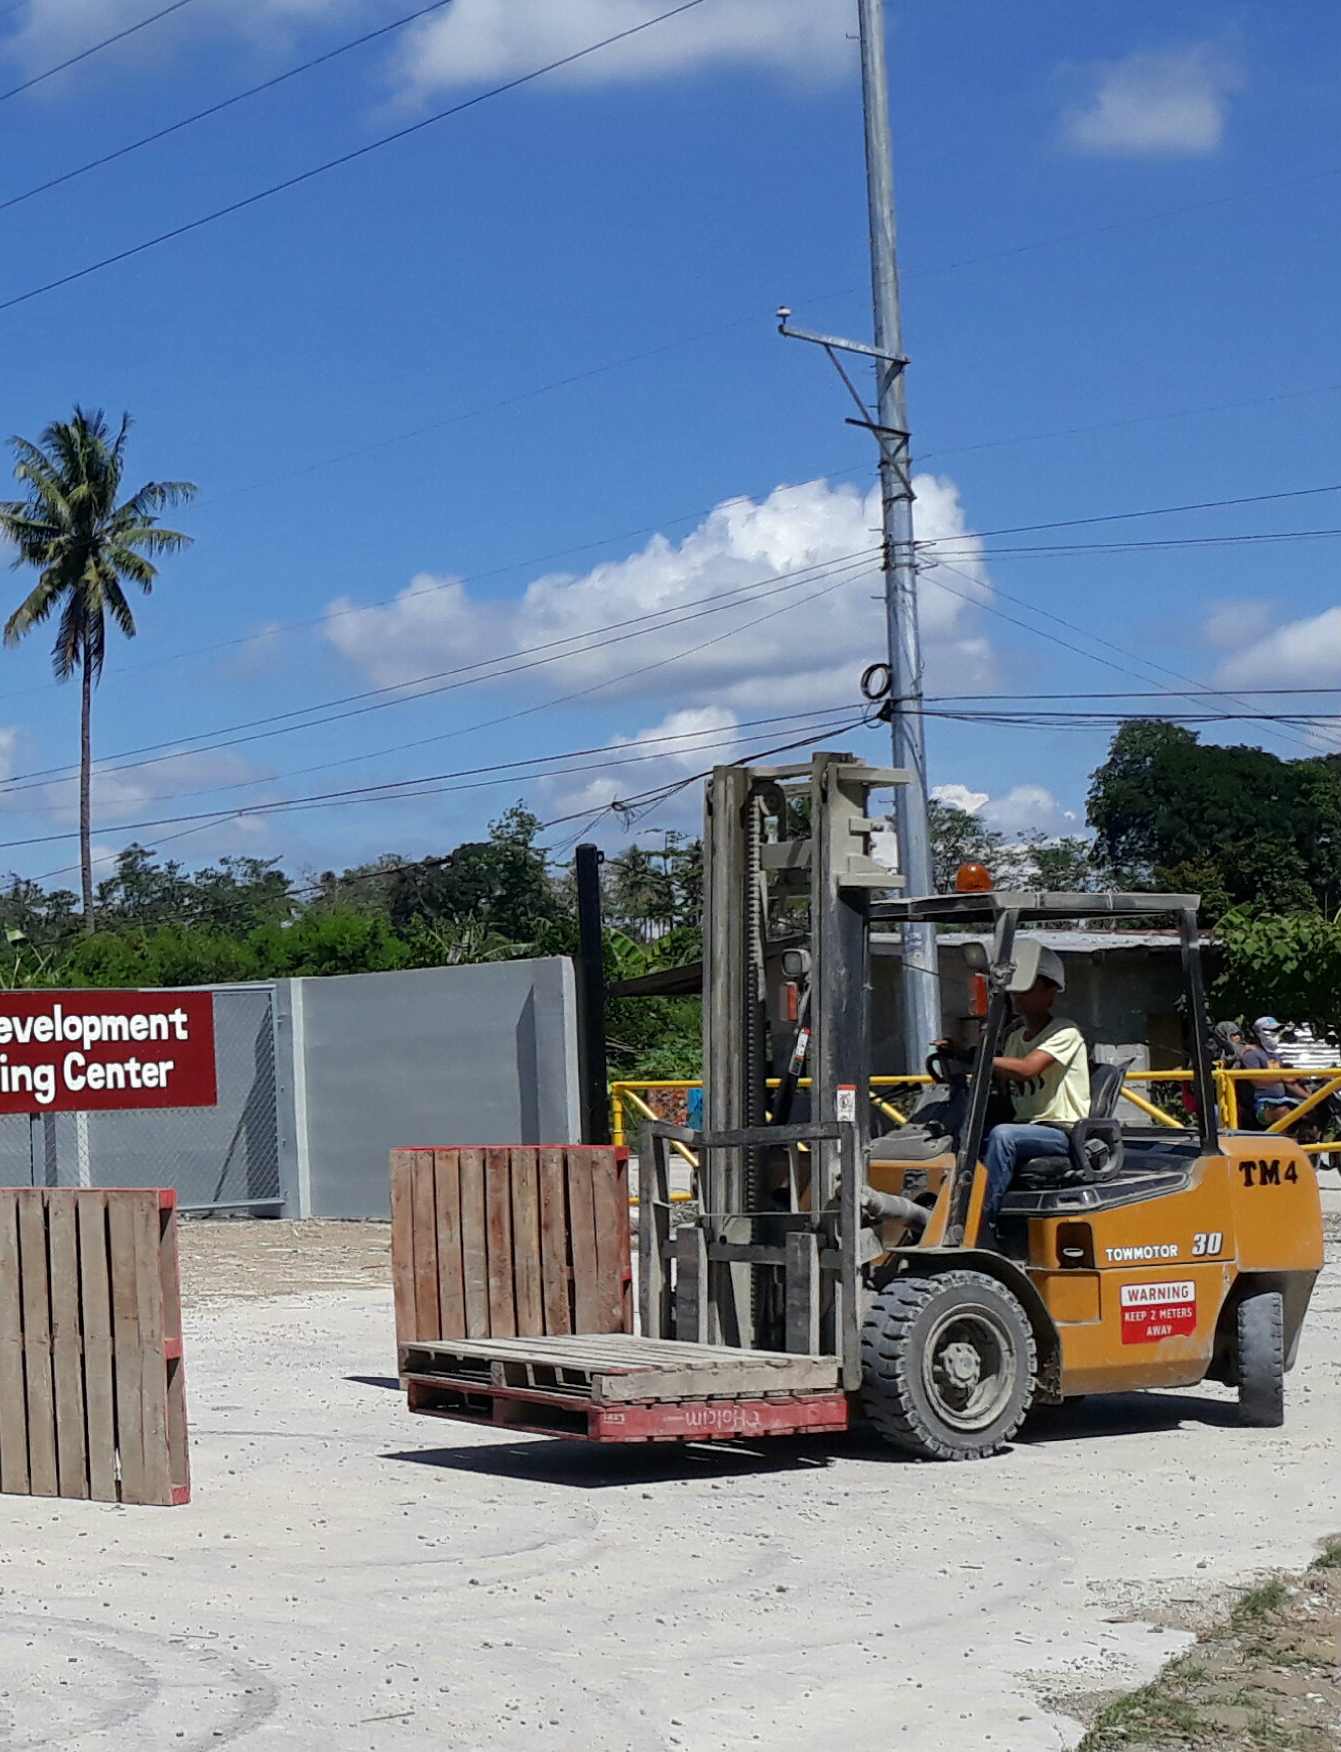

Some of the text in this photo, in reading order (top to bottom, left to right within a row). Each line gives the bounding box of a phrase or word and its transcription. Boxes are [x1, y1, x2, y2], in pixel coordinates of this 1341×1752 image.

[63, 1051, 174, 1093] Center
[1105, 1232, 1223, 1262] TOWMOTOR 30
[1127, 1285, 1189, 1302] WARNING
[1124, 1307, 1193, 1322] KEEP 2 METERS
[1146, 1324, 1173, 1337] AWAY
